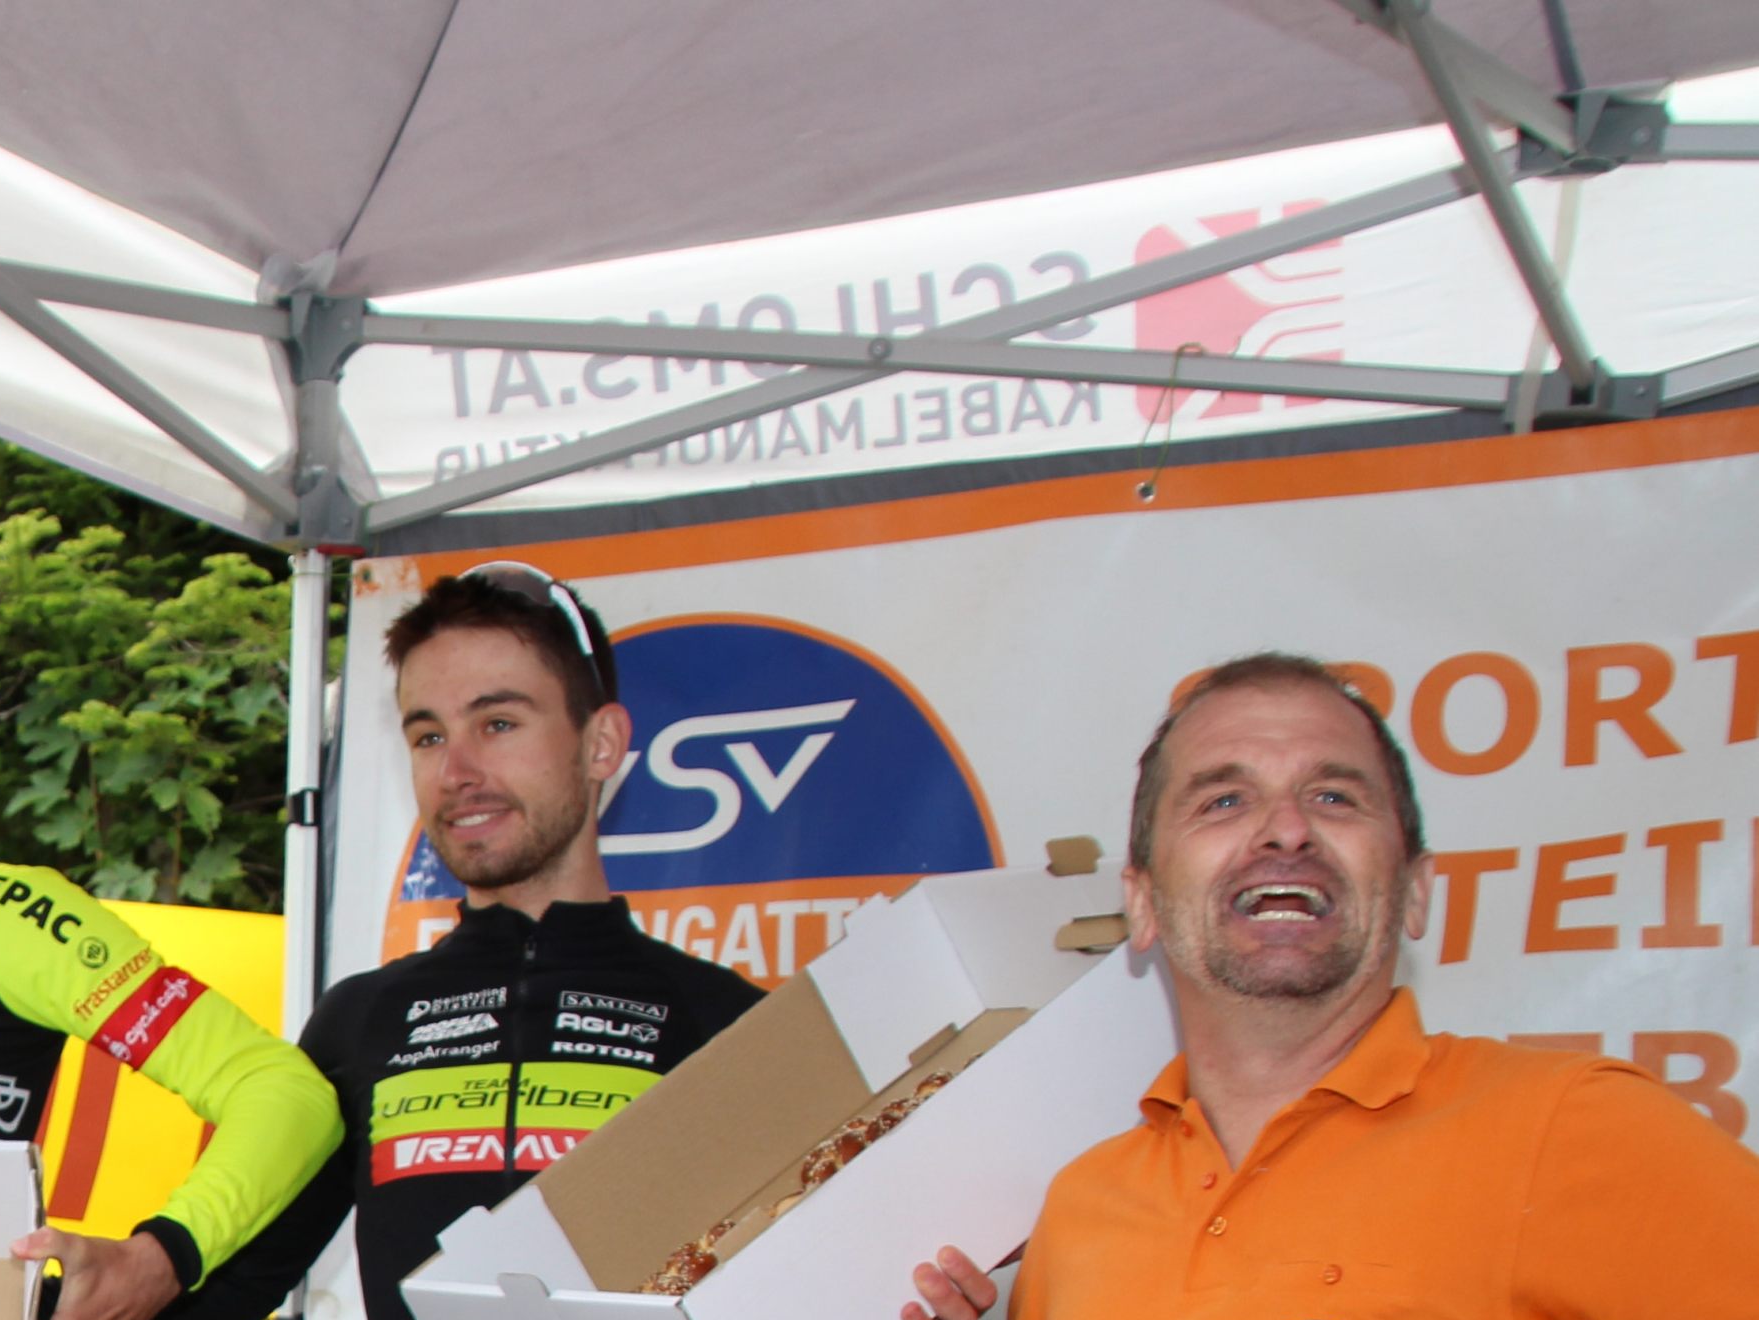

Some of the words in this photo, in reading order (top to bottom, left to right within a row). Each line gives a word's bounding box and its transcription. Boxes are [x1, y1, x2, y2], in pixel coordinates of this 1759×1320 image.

[565, 994, 663, 1018] SAMINA
[556, 1011, 631, 1037] AGU
[388, 1039, 501, 1066] AppArranger
[551, 1040, 655, 1064] ROTOR
[463, 1077, 530, 1091] TEAM
[382, 1083, 635, 1119] vorarlber
[415, 1133, 579, 1166] REMU
